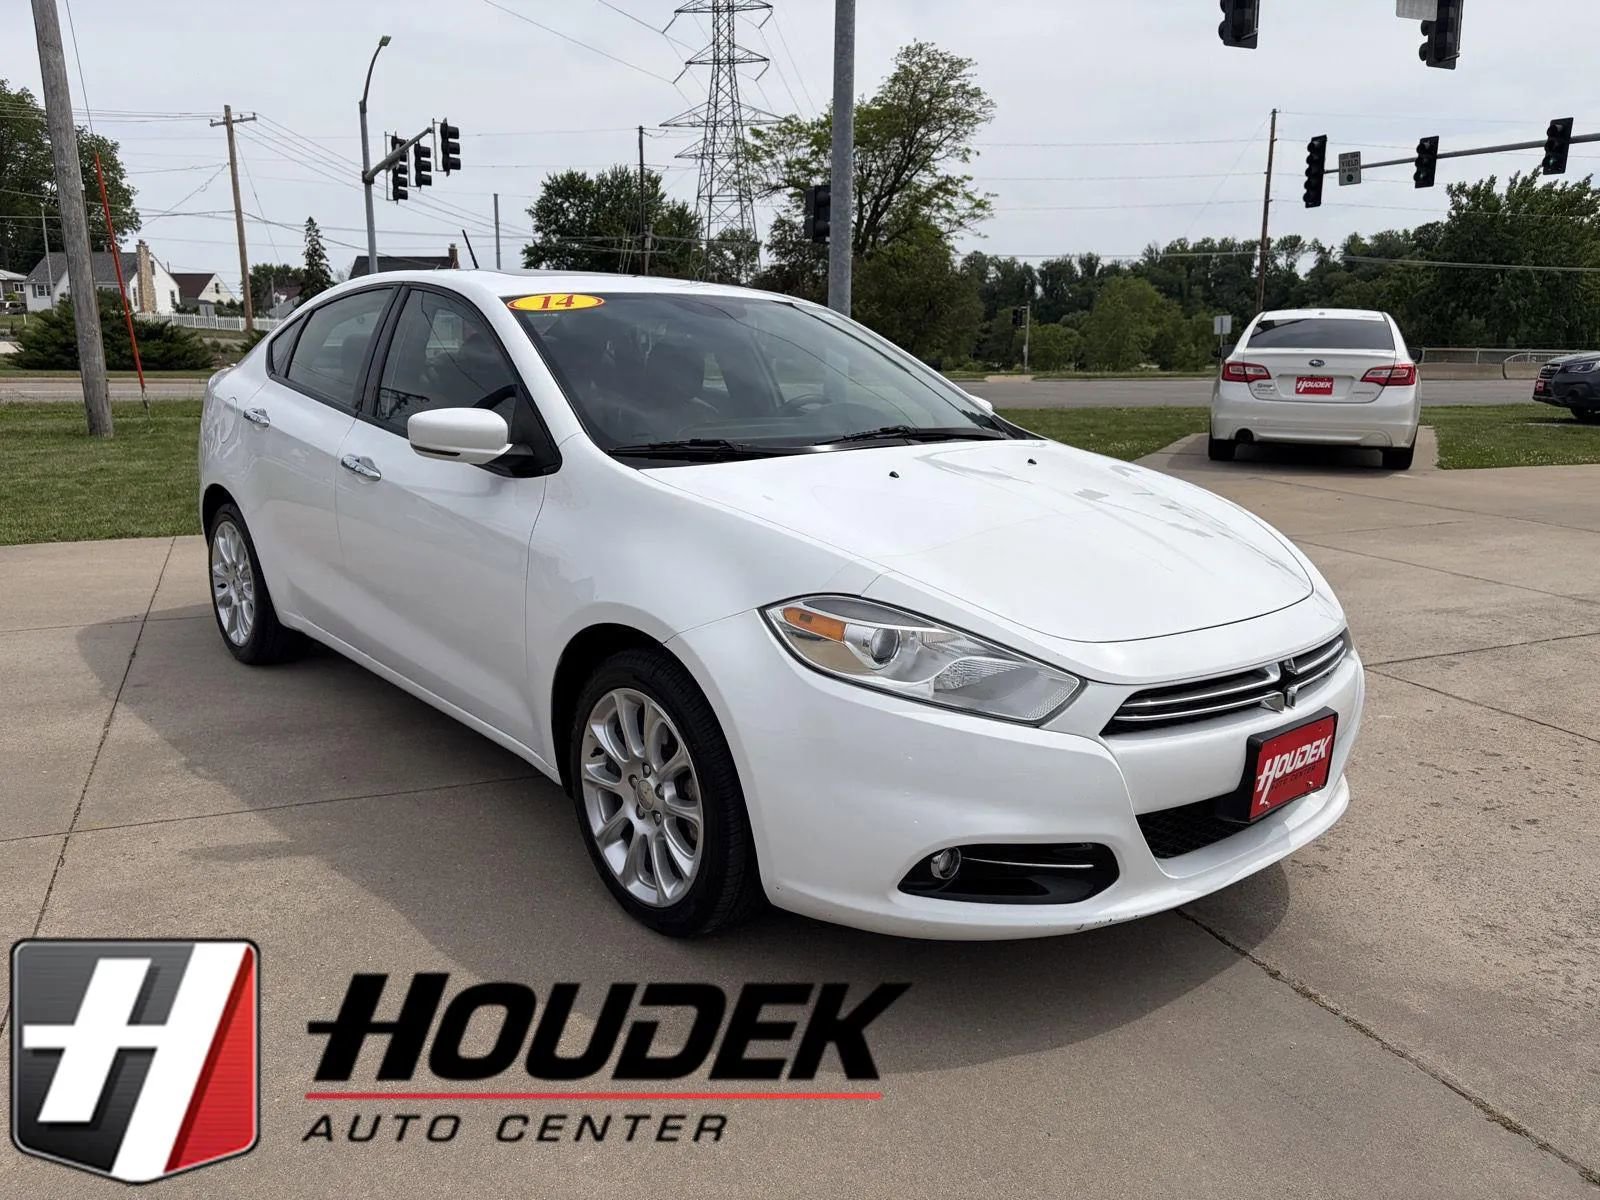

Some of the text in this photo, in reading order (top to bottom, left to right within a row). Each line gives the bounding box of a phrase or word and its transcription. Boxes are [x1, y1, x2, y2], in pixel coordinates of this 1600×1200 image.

[541, 295, 575, 309] 14
[1297, 380, 1332, 392] HOUDEK
[1256, 735, 1332, 806] HOUDEK
